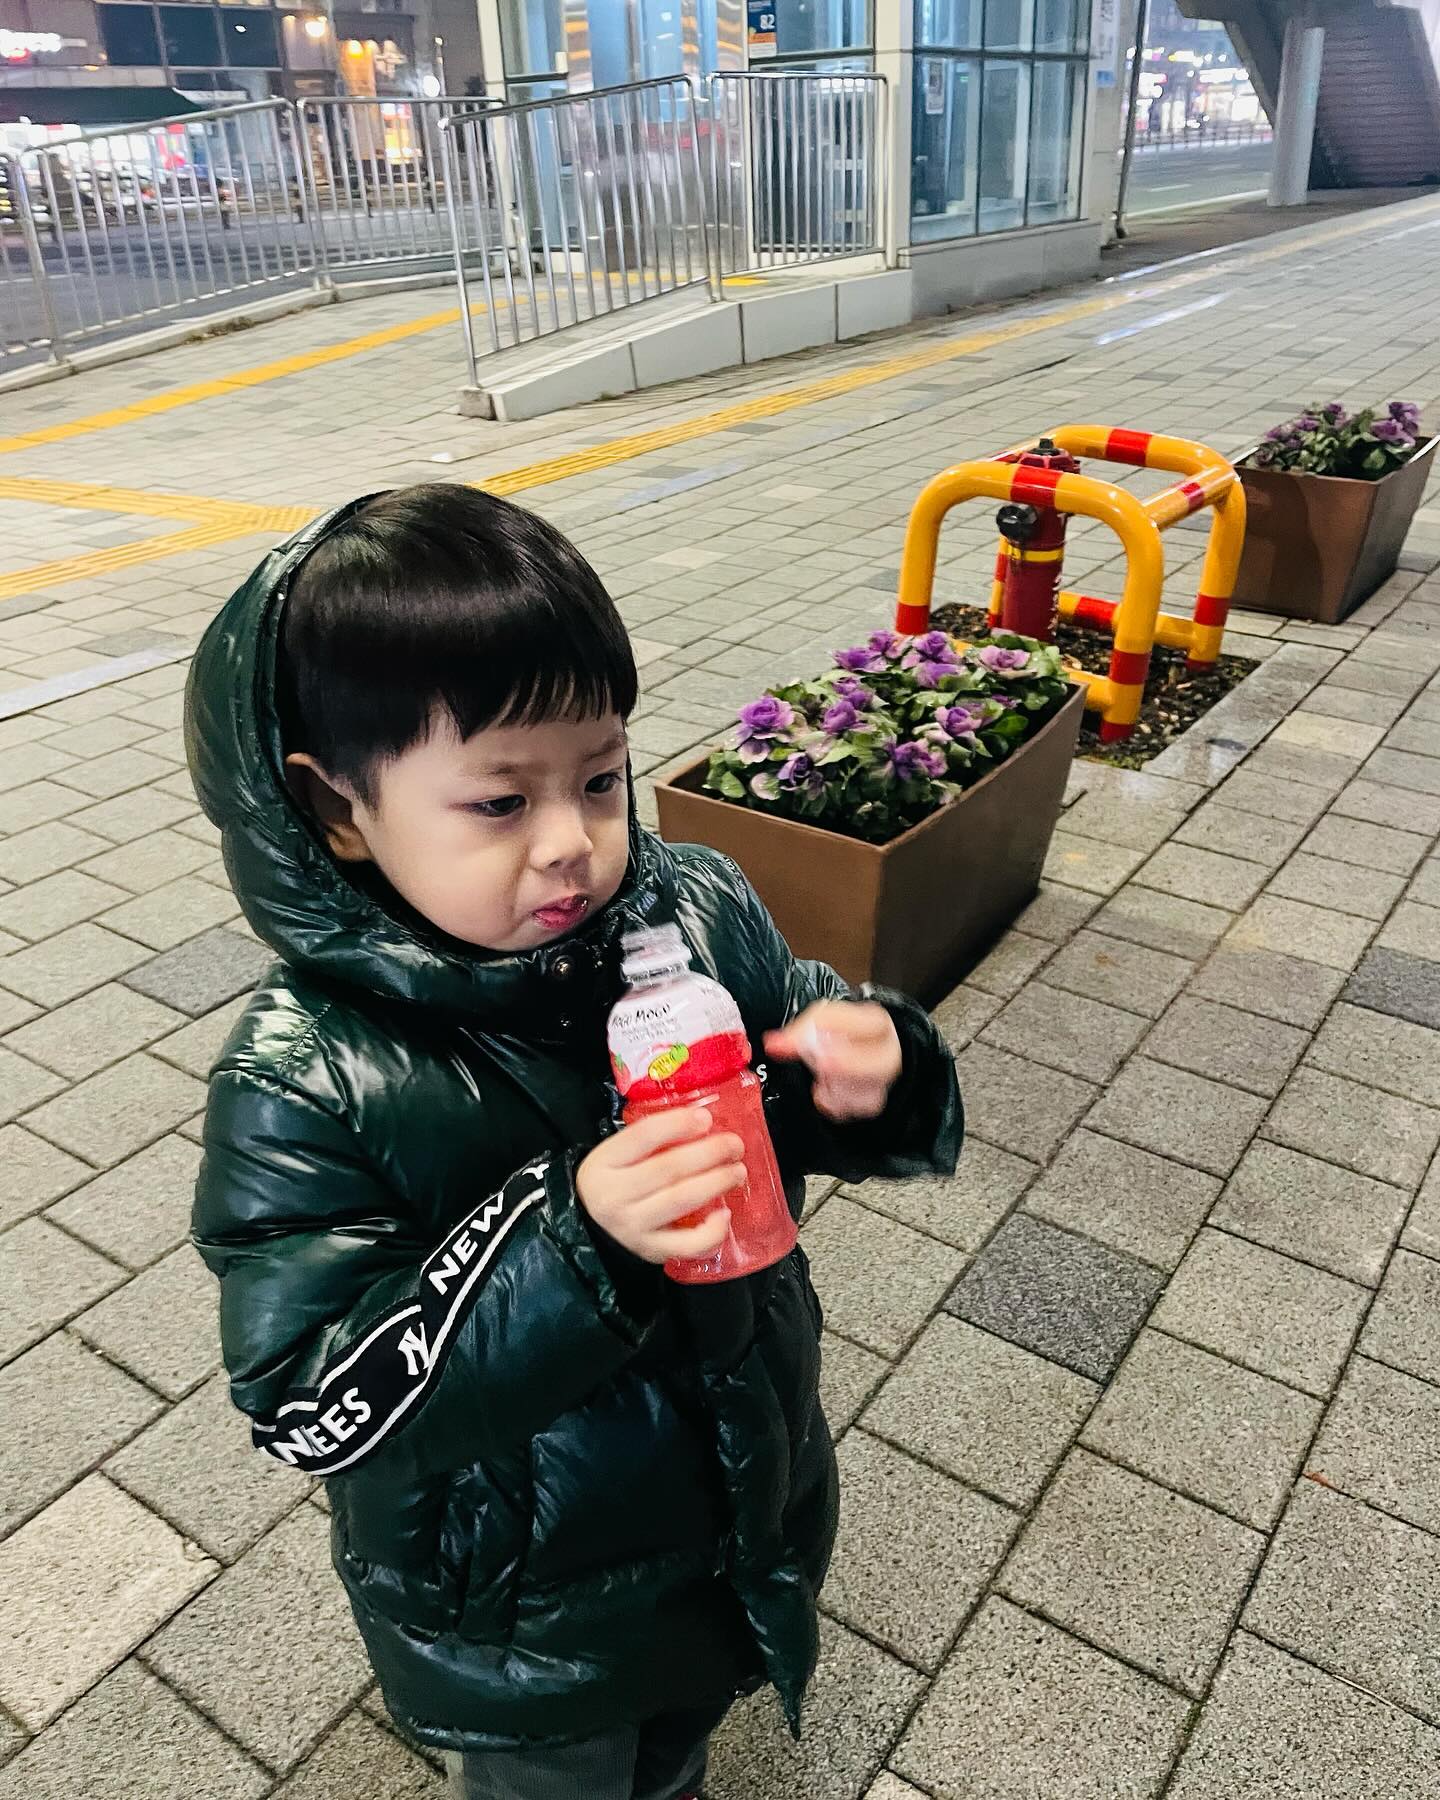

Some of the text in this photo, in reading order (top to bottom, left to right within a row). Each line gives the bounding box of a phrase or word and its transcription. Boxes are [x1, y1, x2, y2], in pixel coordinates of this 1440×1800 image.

[760, 14, 775, 30] 82
[428, 1191, 505, 1296] NEW
[397, 1321, 431, 1376] NY
